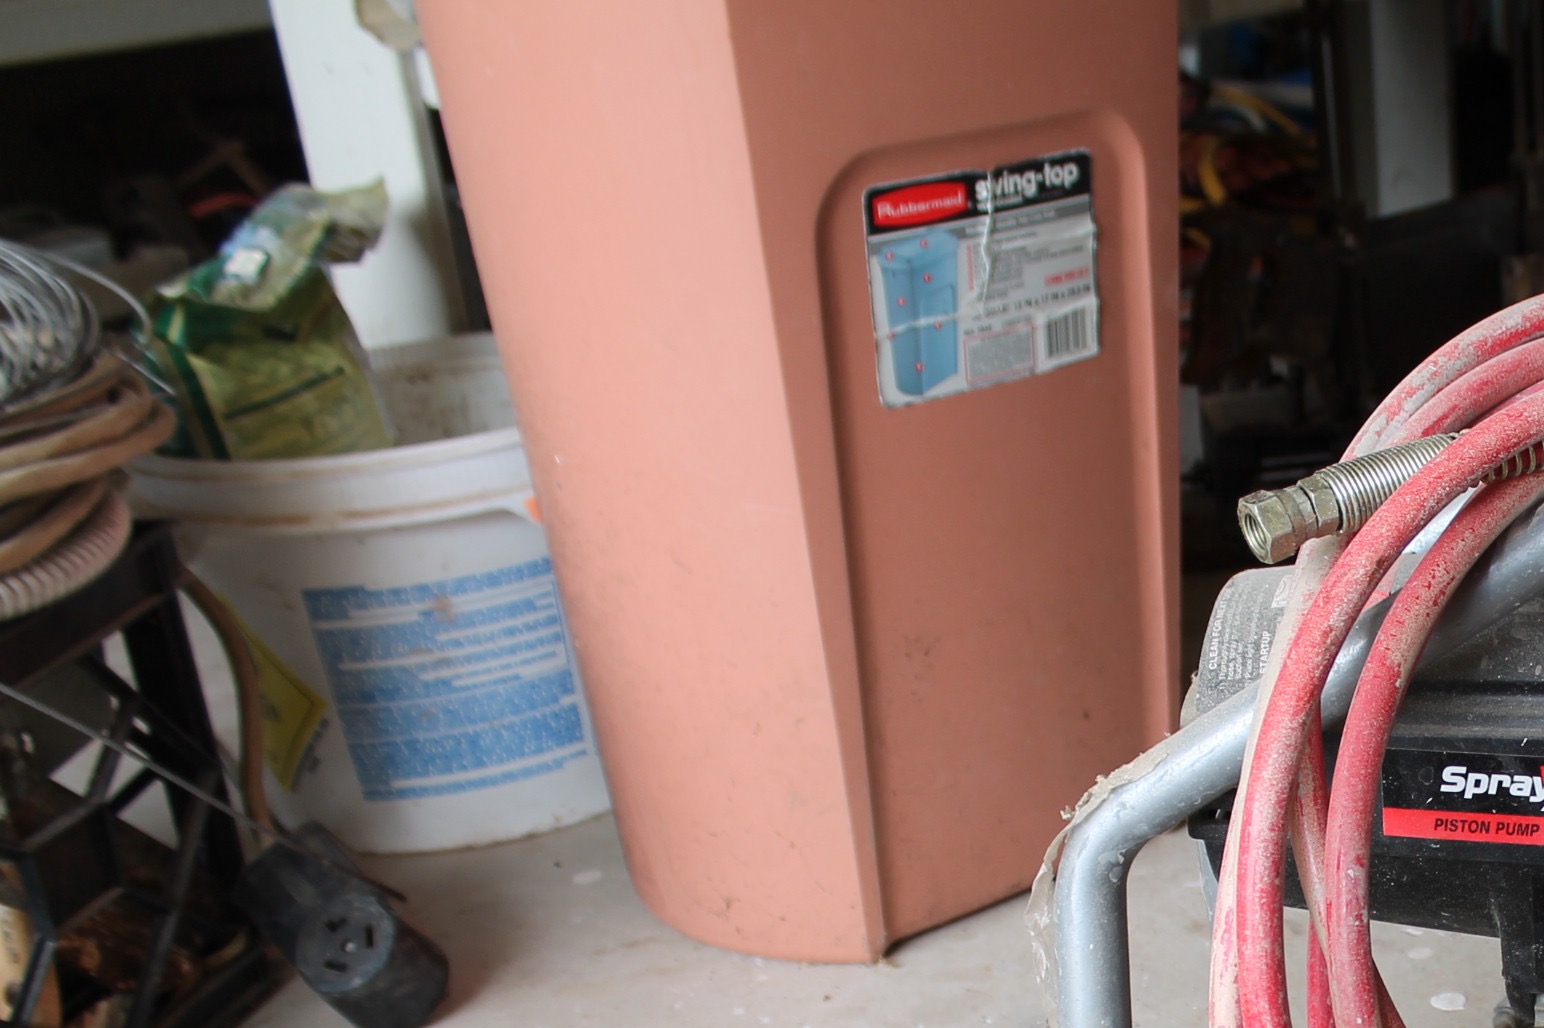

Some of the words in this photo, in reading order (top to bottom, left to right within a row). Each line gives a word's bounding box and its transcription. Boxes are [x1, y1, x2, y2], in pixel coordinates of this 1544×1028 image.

[877, 190, 965, 219] Rubbermaid
[1212, 618, 1222, 638] FOR
[1208, 639, 1220, 670] CLEAN
[1260, 631, 1272, 674] STARTUP
[1434, 818, 1491, 834] PISTON
[1495, 822, 1540, 837] PUMP
